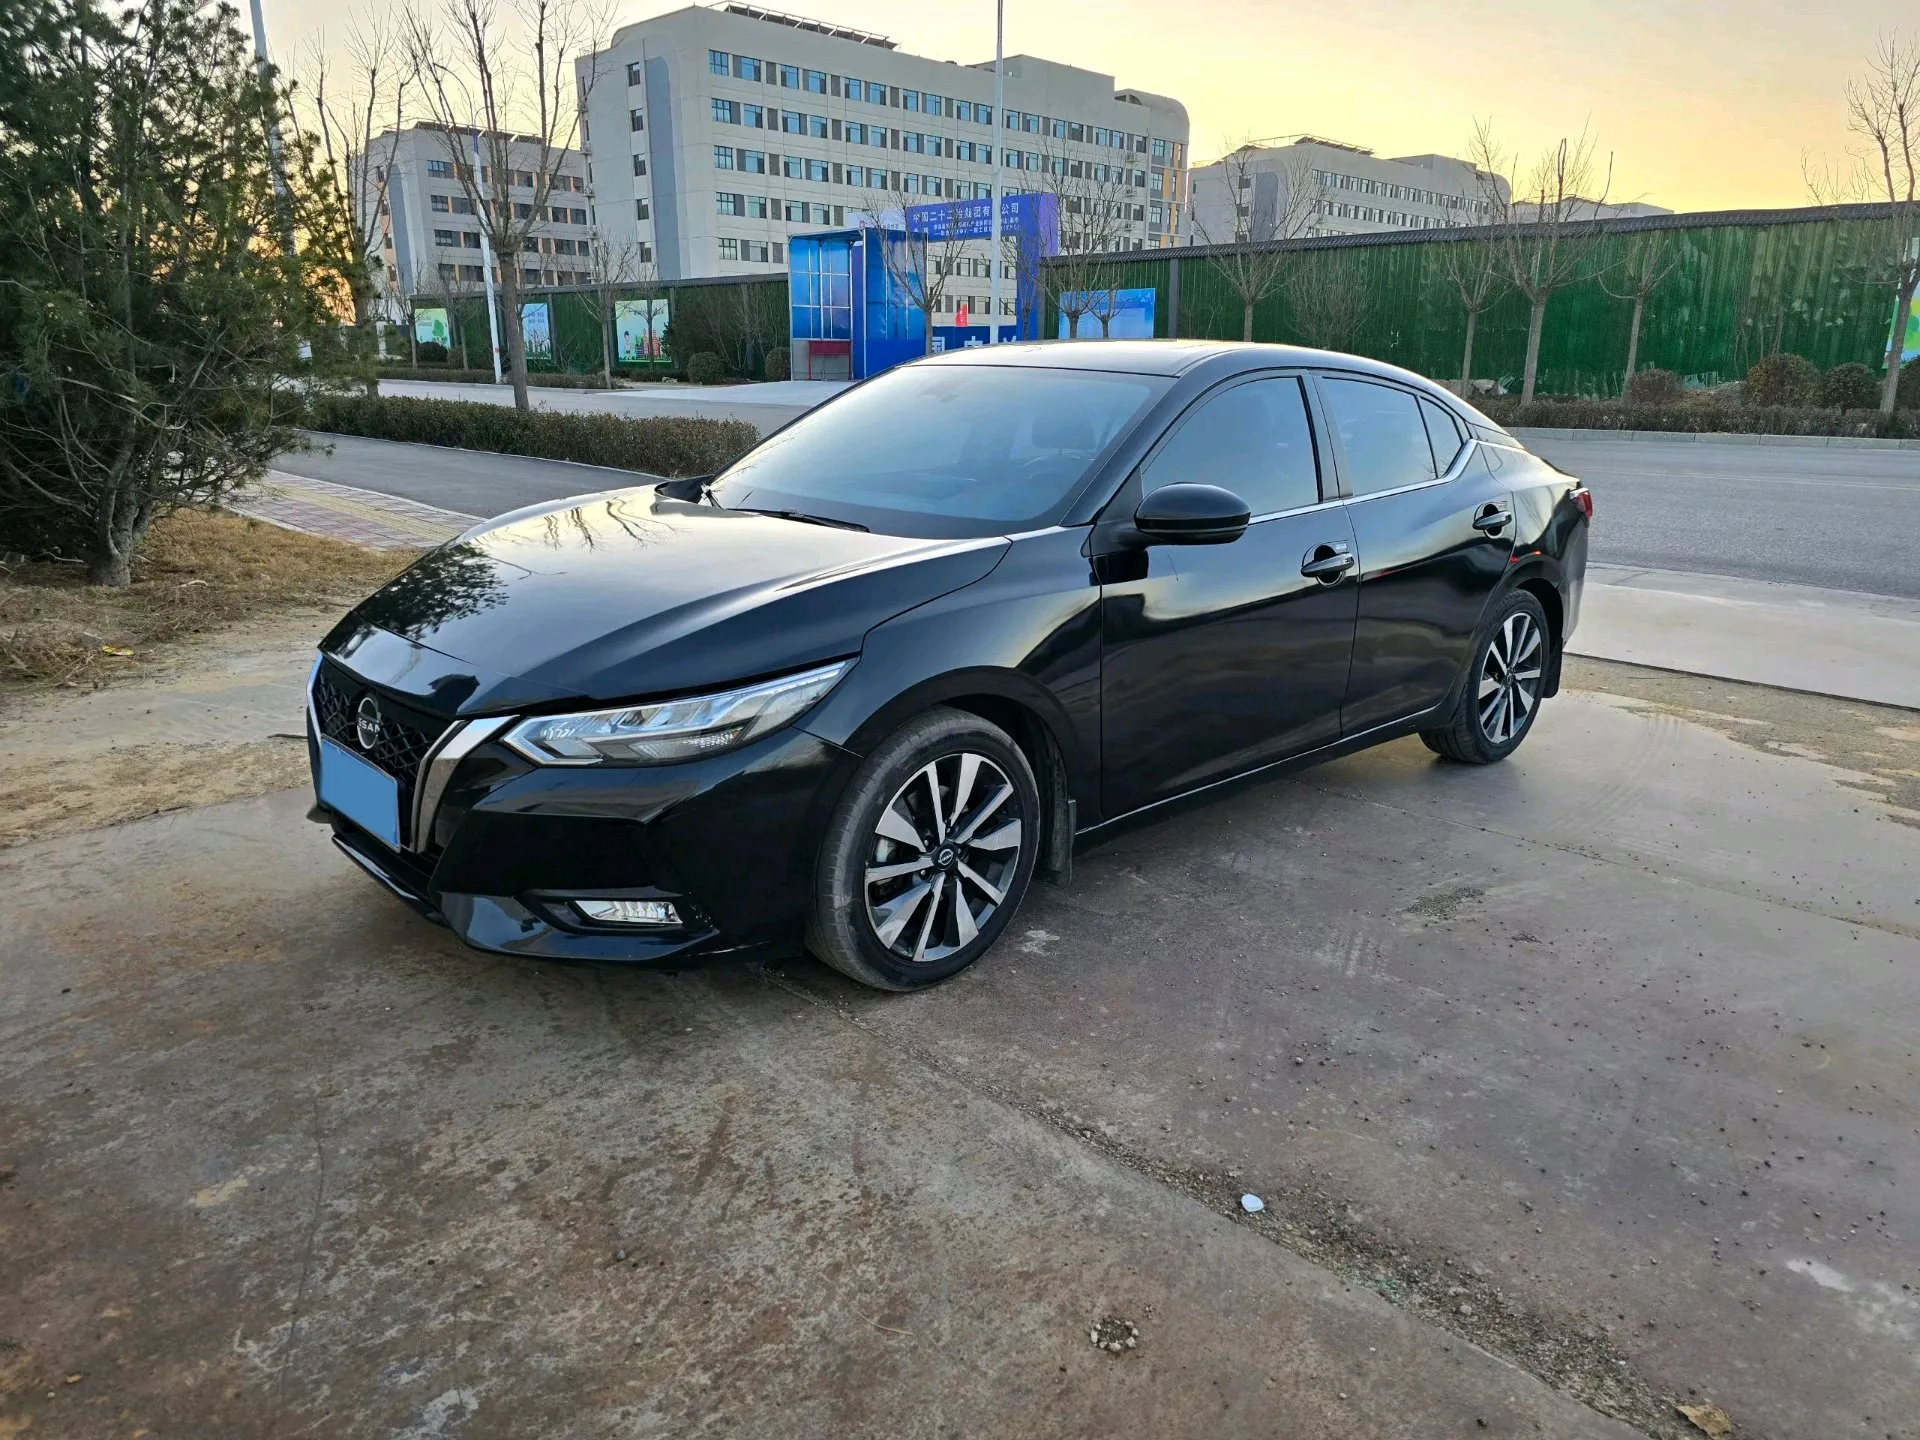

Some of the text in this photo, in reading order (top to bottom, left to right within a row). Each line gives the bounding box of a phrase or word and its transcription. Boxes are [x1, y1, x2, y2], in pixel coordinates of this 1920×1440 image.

[913, 202, 1019, 223] 中国二十二冶集团有公司
